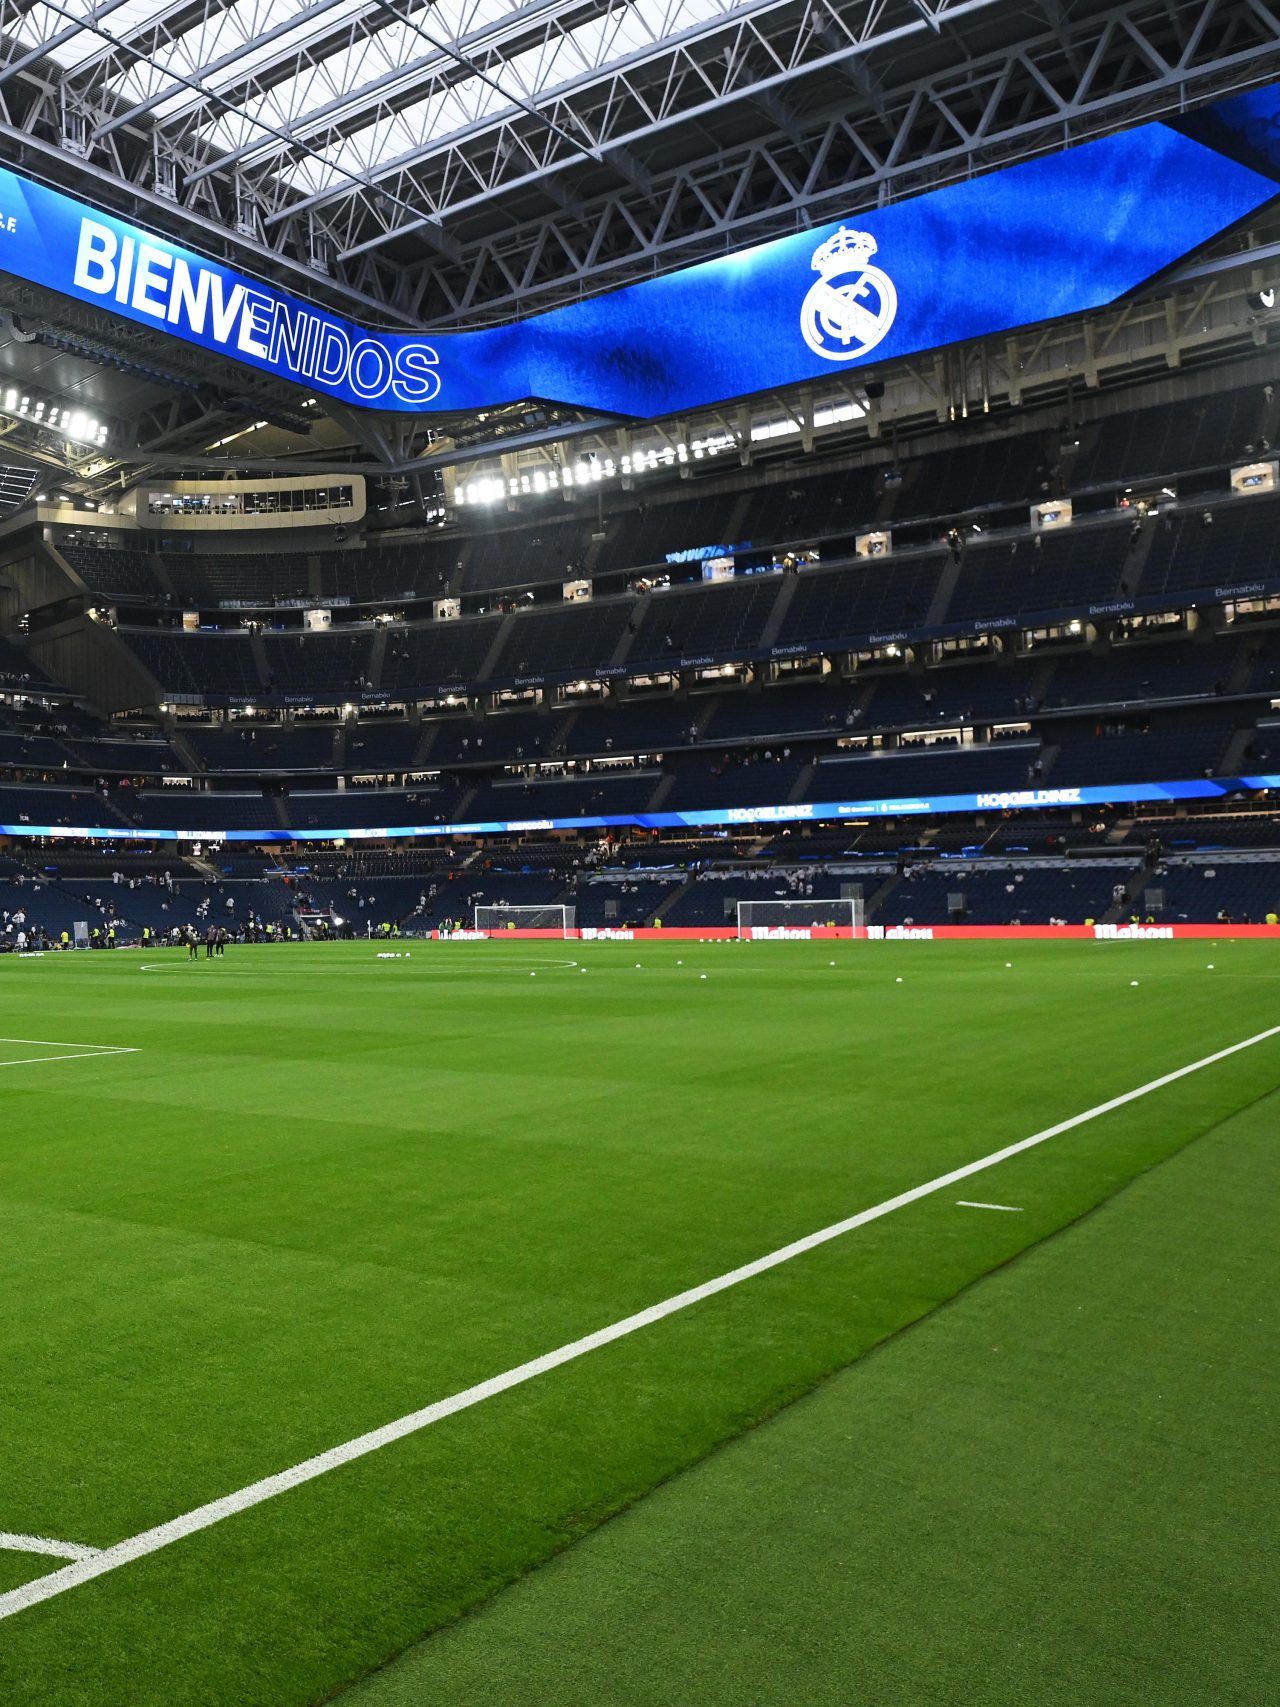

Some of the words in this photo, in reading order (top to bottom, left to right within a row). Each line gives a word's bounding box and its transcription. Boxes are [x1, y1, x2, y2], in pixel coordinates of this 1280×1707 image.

[6, 217, 17, 234] F.
[73, 216, 441, 403] BIENVENIDOS
[1215, 584, 1265, 597] Bernabéu
[1089, 602, 1134, 615] Bernabéu
[974, 618, 1017, 630] Bernabéu
[869, 632, 908, 644] Bernabéu
[771, 645, 807, 655] Bernabéu
[680, 656, 714, 666] Bernabéu
[595, 666, 627, 676] Bernabéu
[514, 676, 545, 685] Bernabéu
[361, 691, 391, 700] Bernabéu
[438, 685, 467, 694] Bernabéu
[581, 928, 634, 940] Mahou
[751, 926, 811, 940] Mahou
[866, 925, 934, 939] Mahou
[1093, 924, 1174, 939] Mahou
